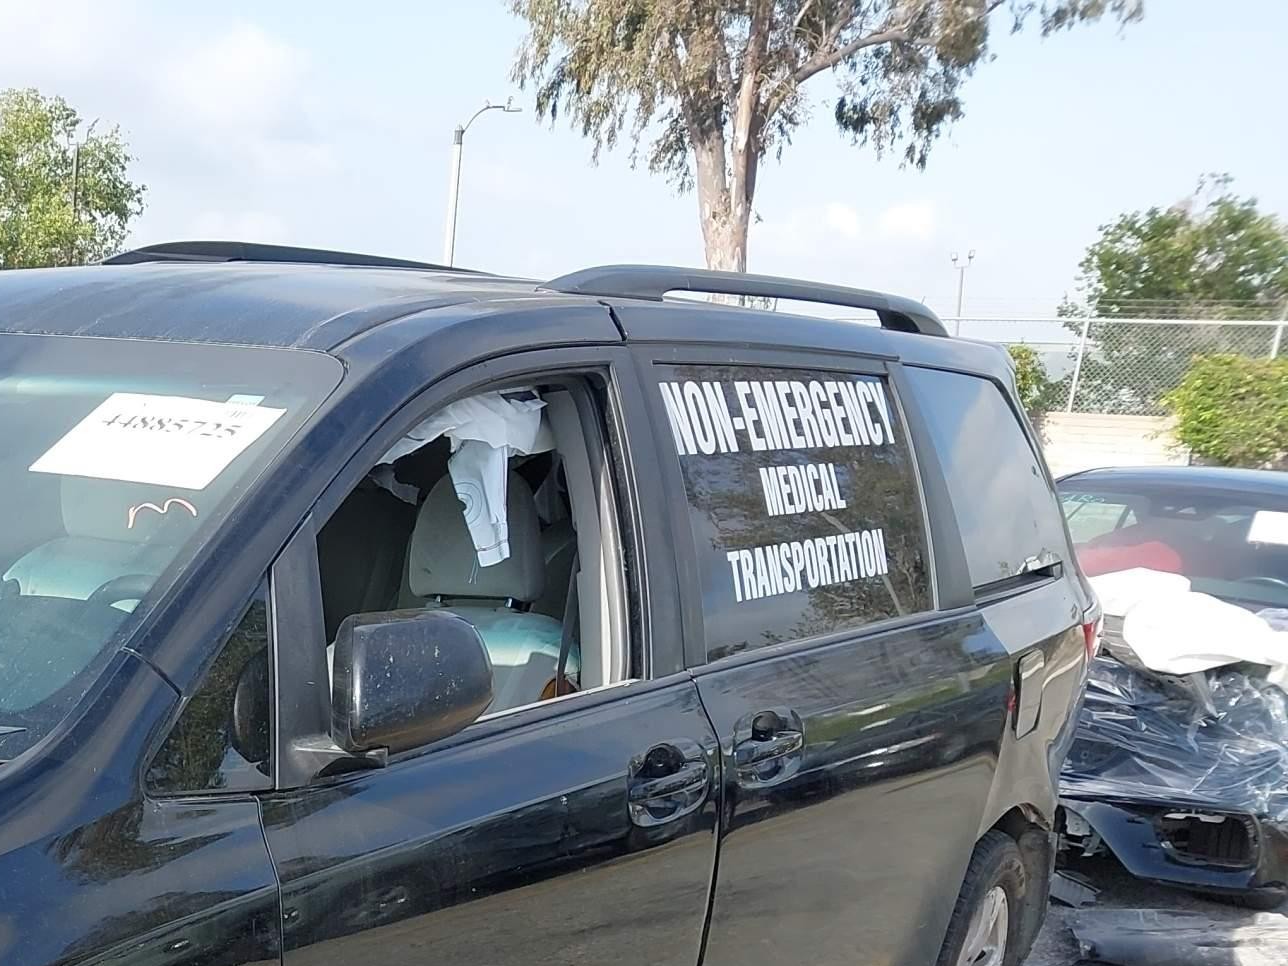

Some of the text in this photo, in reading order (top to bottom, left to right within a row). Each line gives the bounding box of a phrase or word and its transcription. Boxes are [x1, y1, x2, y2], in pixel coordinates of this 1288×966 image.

[101, 413, 243, 438] 44885725
[657, 380, 895, 456] NON-EMERGENCY
[758, 462, 847, 517] MEDICAL
[726, 528, 889, 602] TRANSPORTATION
